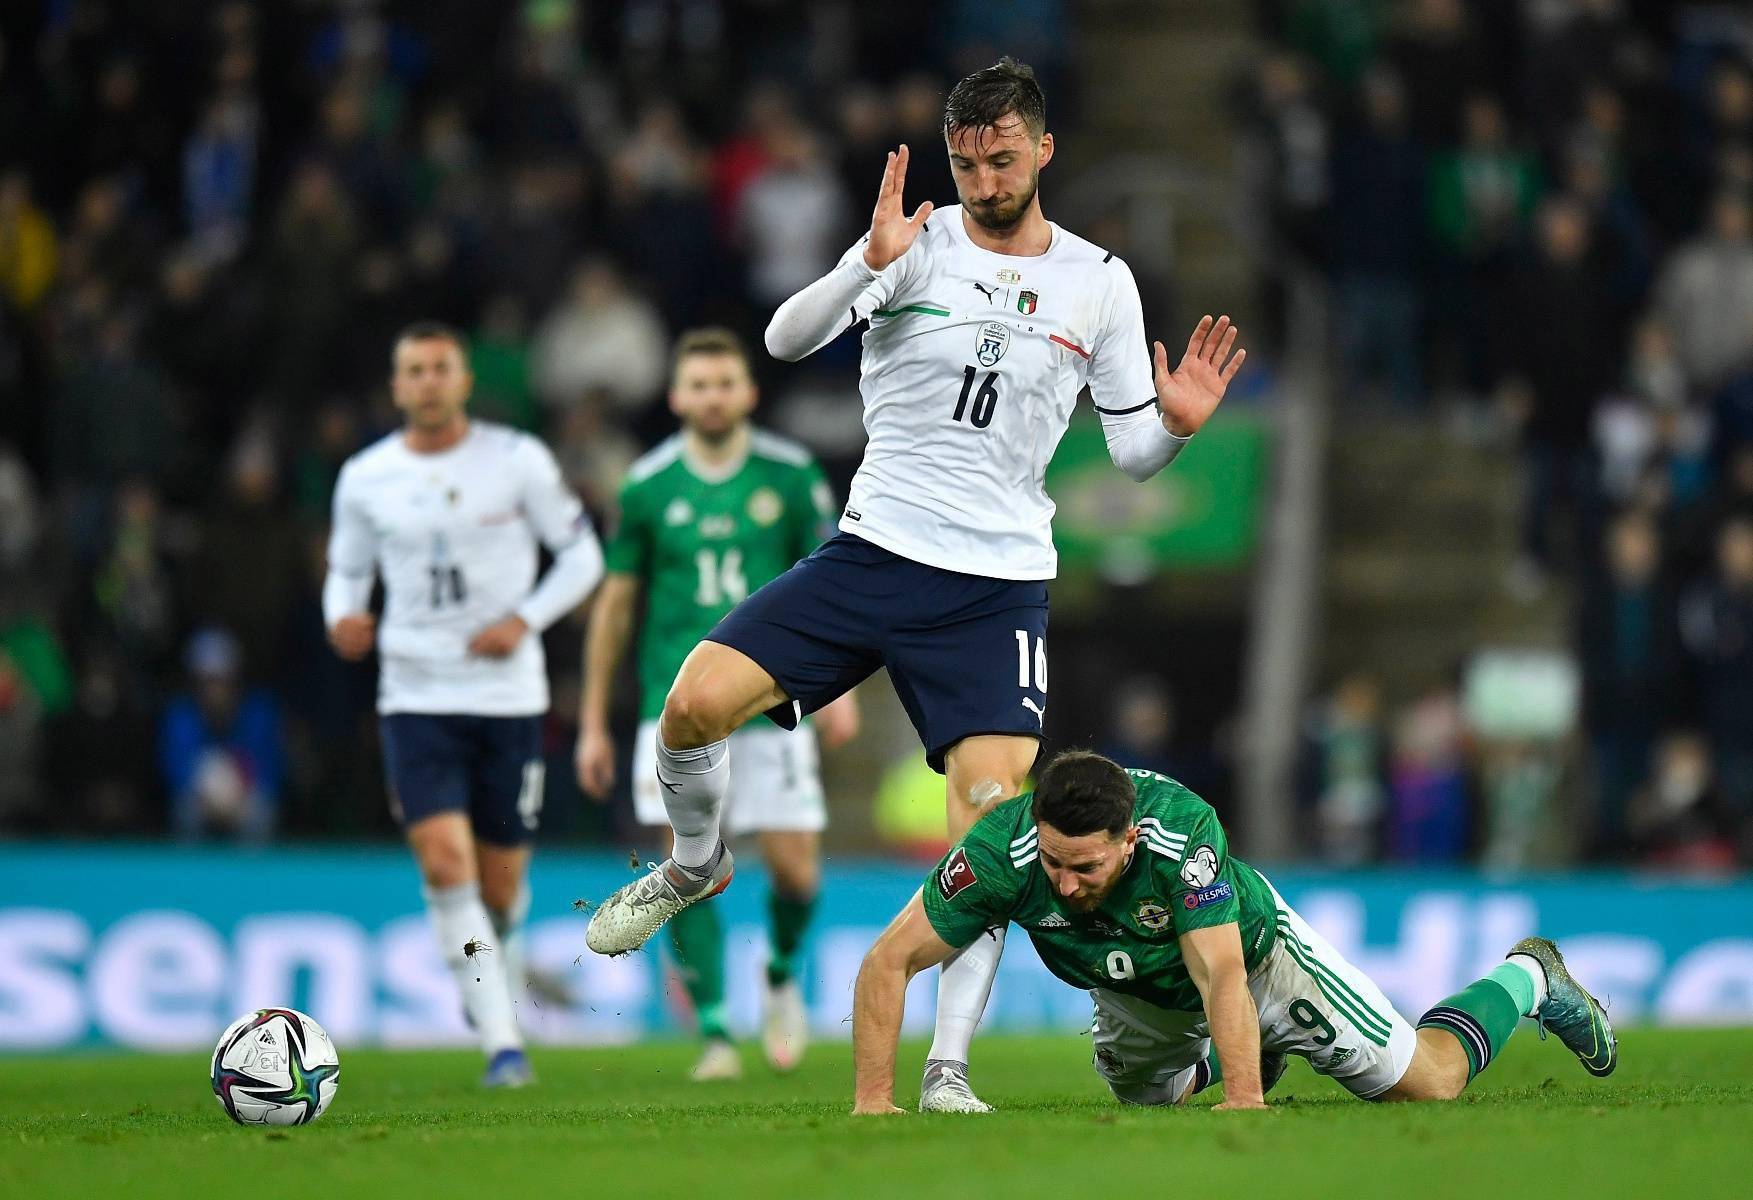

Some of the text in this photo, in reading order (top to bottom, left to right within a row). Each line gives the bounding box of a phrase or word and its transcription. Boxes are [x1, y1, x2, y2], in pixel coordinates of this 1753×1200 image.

[953, 365, 999, 428] 16
[1015, 629, 1048, 694] 16
[1197, 884, 1231, 903] RESPECT
[1288, 999, 1337, 1046] 9
